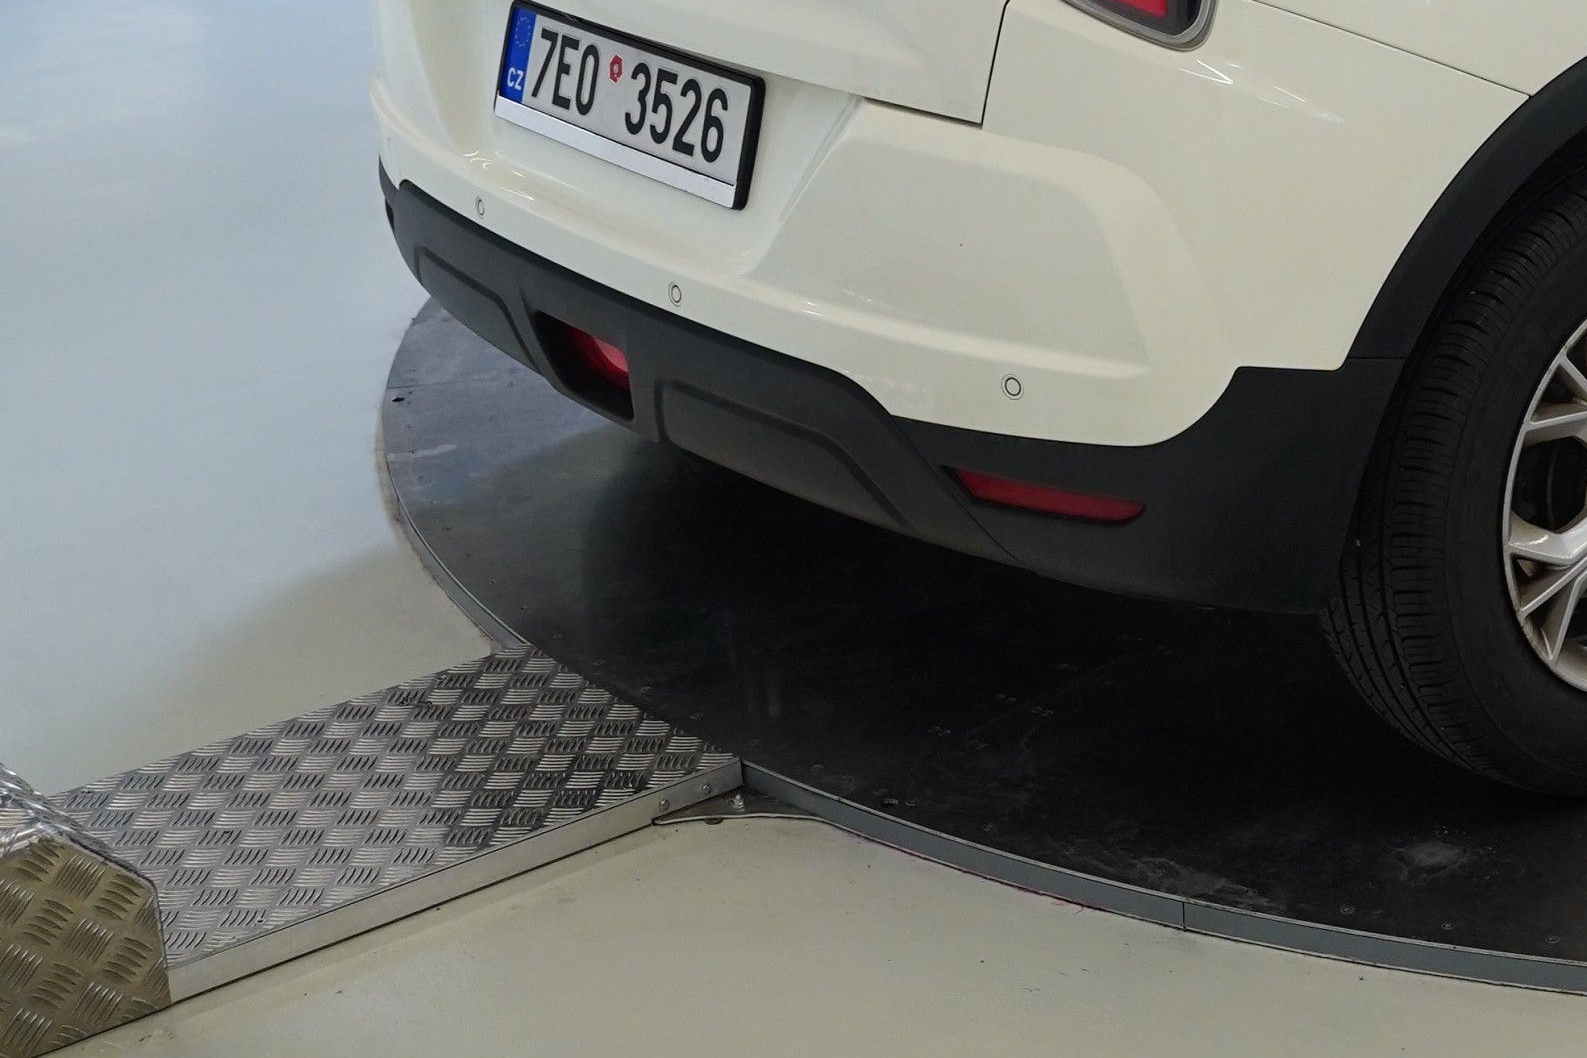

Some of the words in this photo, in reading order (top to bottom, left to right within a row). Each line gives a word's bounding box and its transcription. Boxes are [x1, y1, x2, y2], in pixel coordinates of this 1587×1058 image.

[507, 65, 526, 93] CZ
[531, 27, 600, 116] 7E0
[624, 61, 729, 163] 3526
